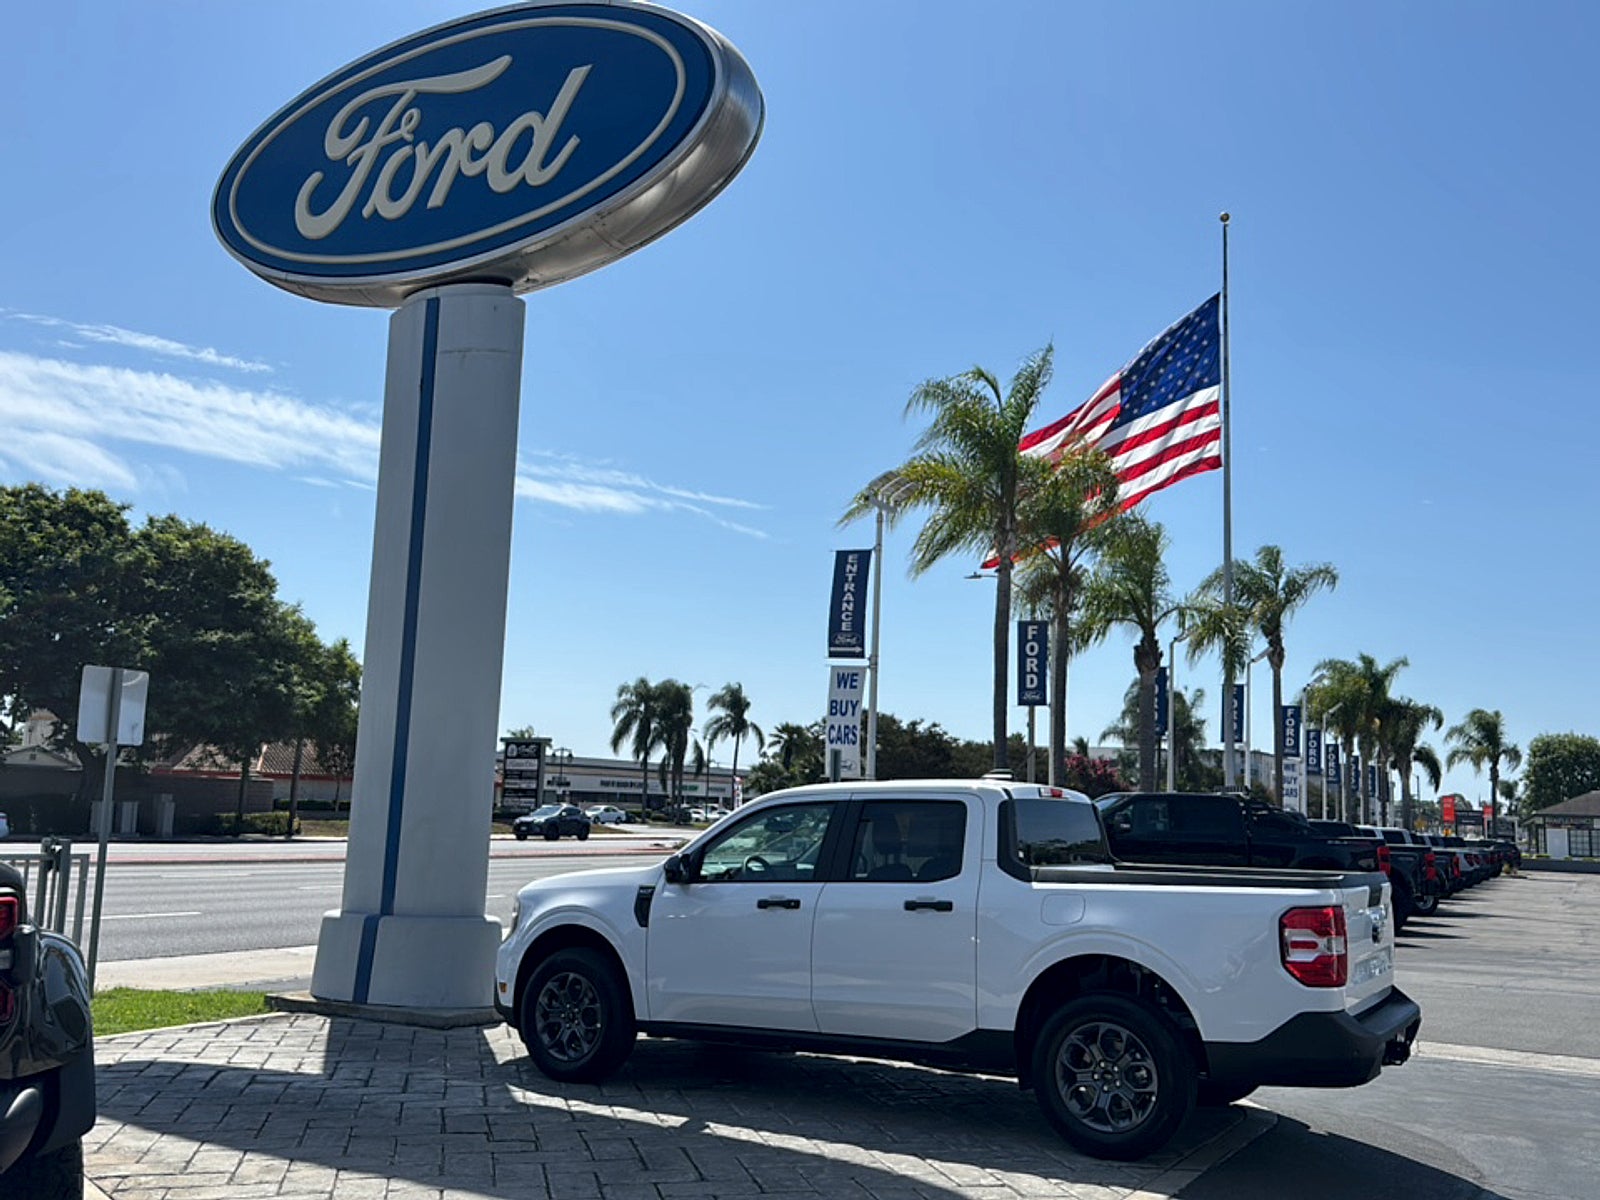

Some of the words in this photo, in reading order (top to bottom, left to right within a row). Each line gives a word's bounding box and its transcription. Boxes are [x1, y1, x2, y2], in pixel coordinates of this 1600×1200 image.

[294, 55, 593, 240] Ford
[840, 554, 859, 632] ENTRANCE
[1025, 625, 1039, 689] FORD
[836, 672, 859, 689] WE
[829, 700, 859, 716] BUY
[828, 726, 858, 745] CARS
[1285, 708, 1295, 747] FORD
[1308, 732, 1318, 765] FORD
[1328, 745, 1337, 776] FORD
